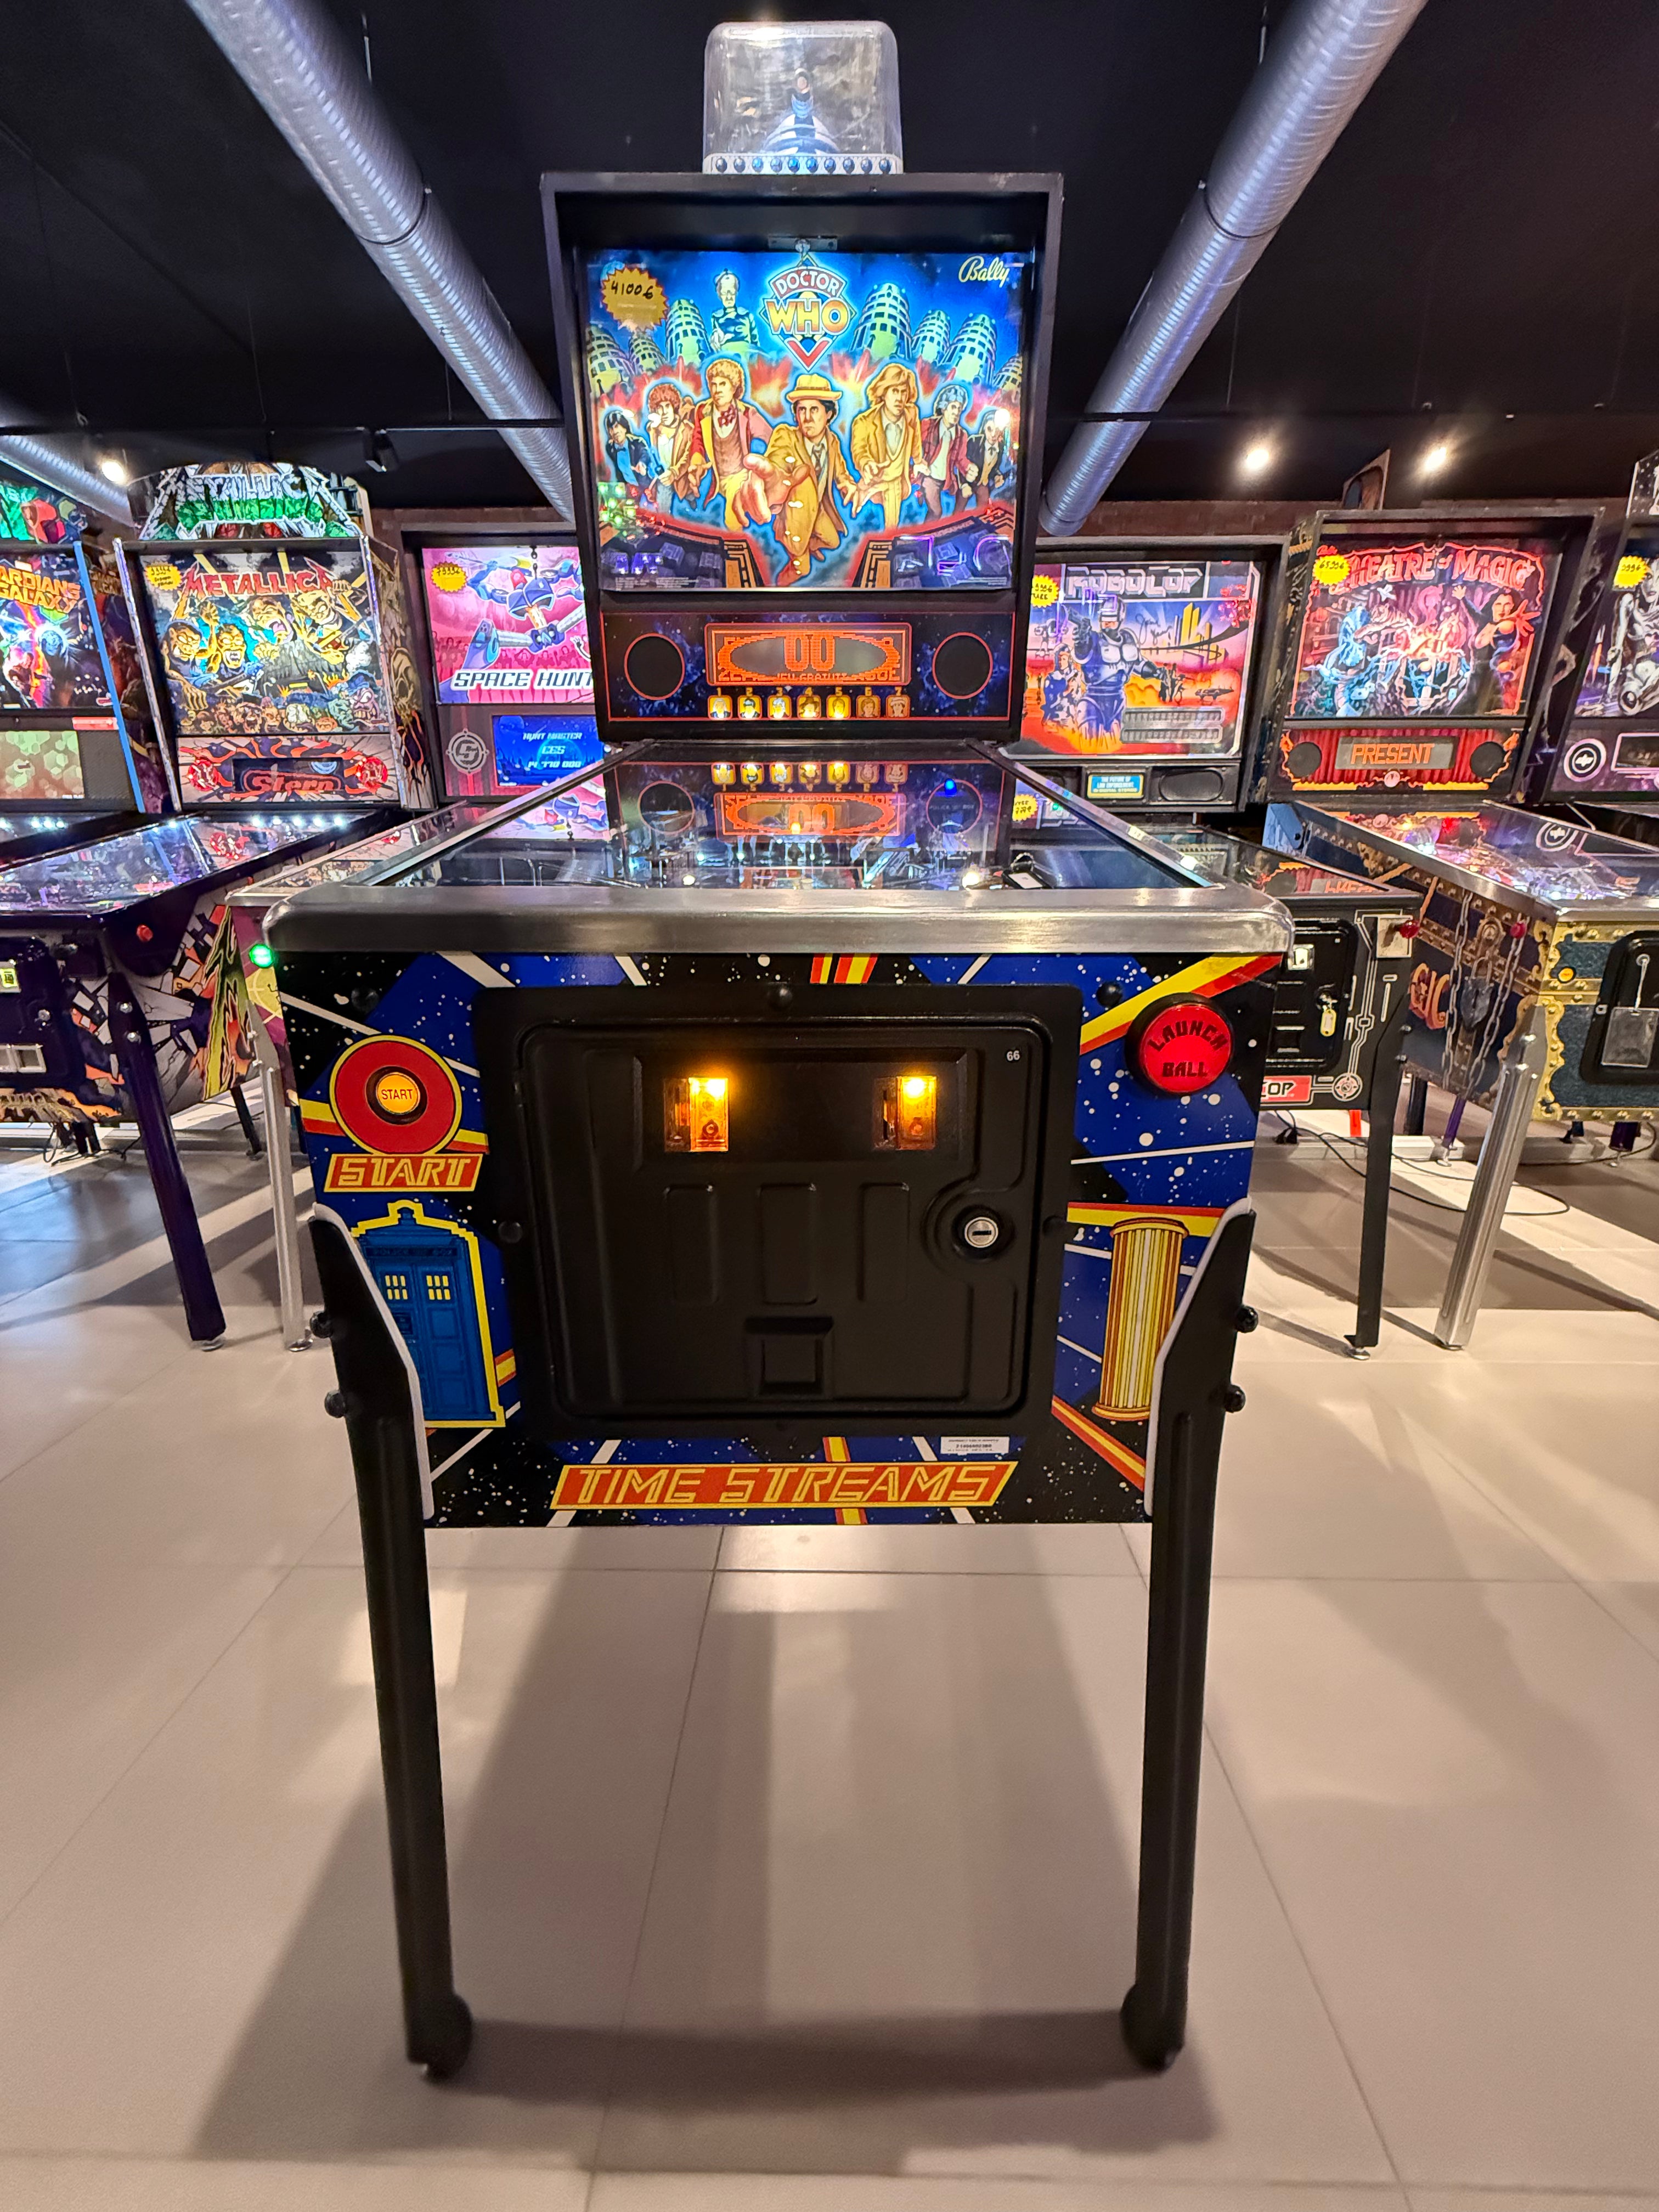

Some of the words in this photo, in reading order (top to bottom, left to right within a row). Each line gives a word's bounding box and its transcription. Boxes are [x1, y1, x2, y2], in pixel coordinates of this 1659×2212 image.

[775, 270, 839, 296] DOCTOR
[958, 255, 1010, 288] Bally
[764, 298, 850, 335] WHO
[177, 557, 343, 602] METALLICA
[1347, 551, 1436, 589] HEATRE
[454, 673, 531, 686] SPACE
[1351, 743, 1435, 764] PRESENT
[1147, 1020, 1229, 1052] LAUNCH
[1006, 1050, 1020, 1062] 66
[1162, 1061, 1207, 1077] BALL
[381, 1089, 413, 1100] START
[338, 1158, 471, 1187] START
[579, 1468, 705, 1504] TIME
[721, 1466, 996, 1501] STREAMS
